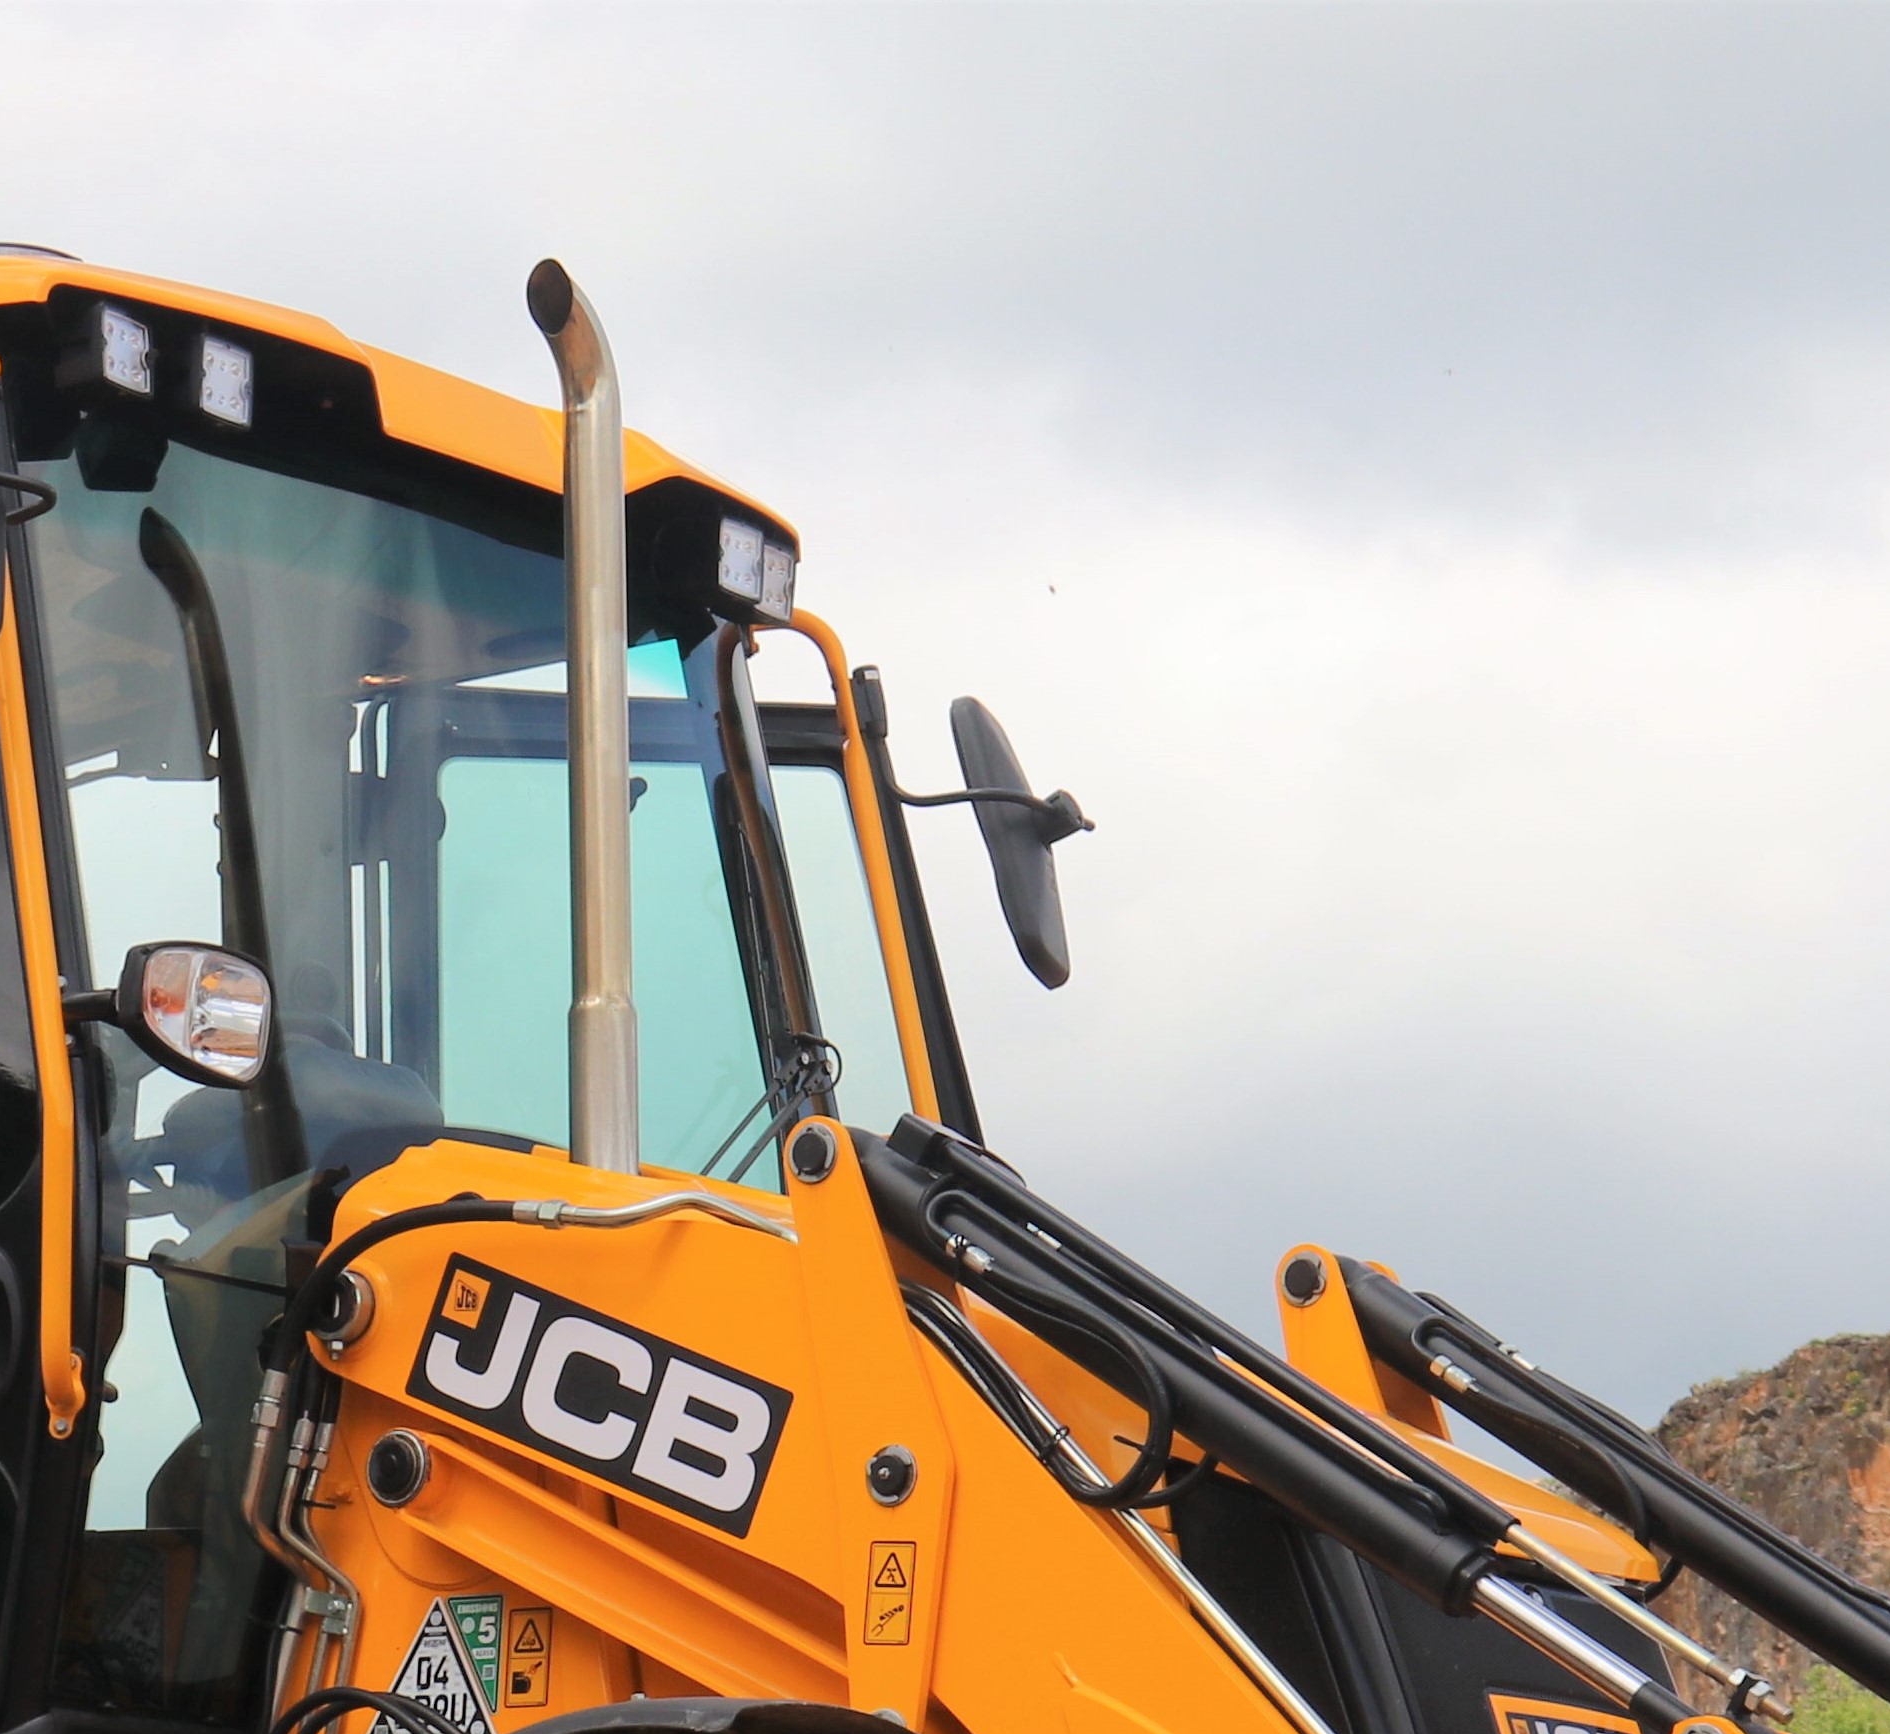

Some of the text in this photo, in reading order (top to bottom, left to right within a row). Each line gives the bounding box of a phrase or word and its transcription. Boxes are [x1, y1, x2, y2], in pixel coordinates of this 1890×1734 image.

[457, 1285, 477, 1308] JCB
[425, 1292, 772, 1512] JCB
[477, 1616, 496, 1644] 5
